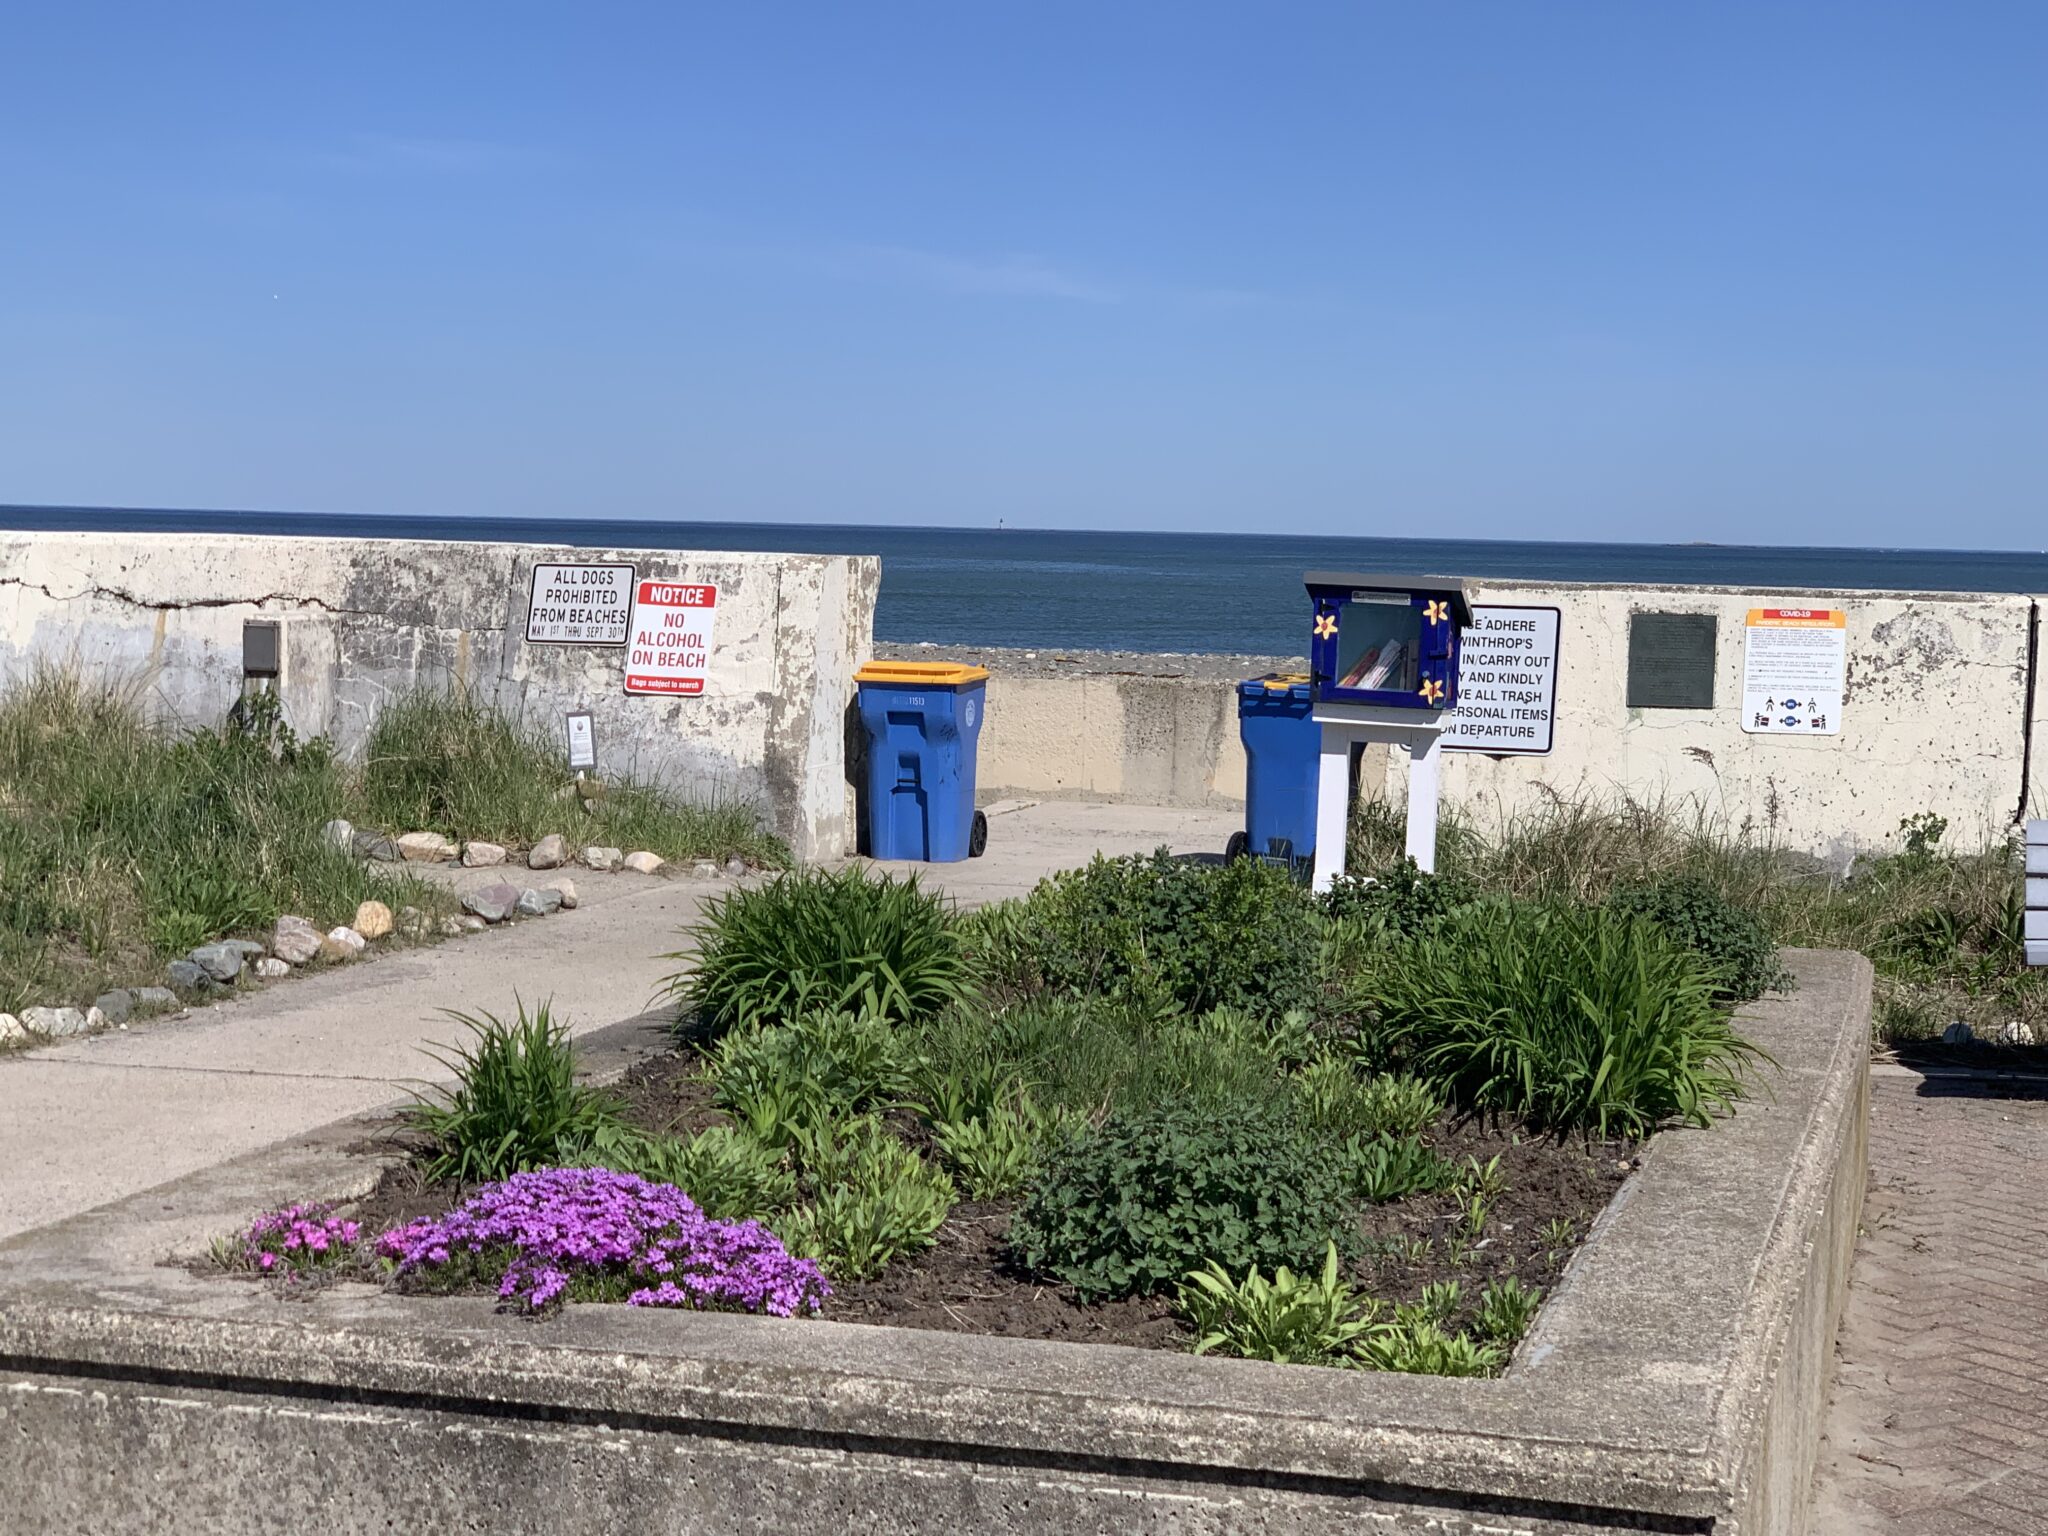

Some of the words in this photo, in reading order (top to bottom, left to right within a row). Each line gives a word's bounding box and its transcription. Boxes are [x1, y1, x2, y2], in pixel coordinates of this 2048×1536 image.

[554, 570, 577, 584] ALL
[582, 570, 614, 585] DOGS
[545, 589, 618, 604] PROHIBITED
[650, 586, 705, 604] NOTICE
[532, 608, 566, 622] FROM
[569, 609, 626, 624] BEACHES
[664, 613, 685, 628] NO
[531, 625, 546, 636] MAY
[565, 626, 582, 637] THRU
[586, 626, 604, 638] SEPT
[608, 627, 624, 638] 30TH
[1485, 619, 1536, 632] ADHERE
[637, 631, 705, 648] ALCOHOL
[632, 650, 653, 665] ON
[658, 651, 706, 668] BEACH
[1462, 654, 1521, 667] IN/CARRY
[1524, 656, 1550, 668] OUT
[631, 677, 647, 687] Bags
[648, 679, 671, 689] subject
[671, 680, 678, 688] to
[678, 681, 699, 689] search
[1468, 672, 1495, 683] AND
[1498, 673, 1543, 685] KINDLY
[1475, 689, 1498, 701] ALL
[1501, 690, 1542, 703] TRASH
[1511, 708, 1548, 720] ITEMS
[1461, 724, 1535, 738] DEPARTURE
